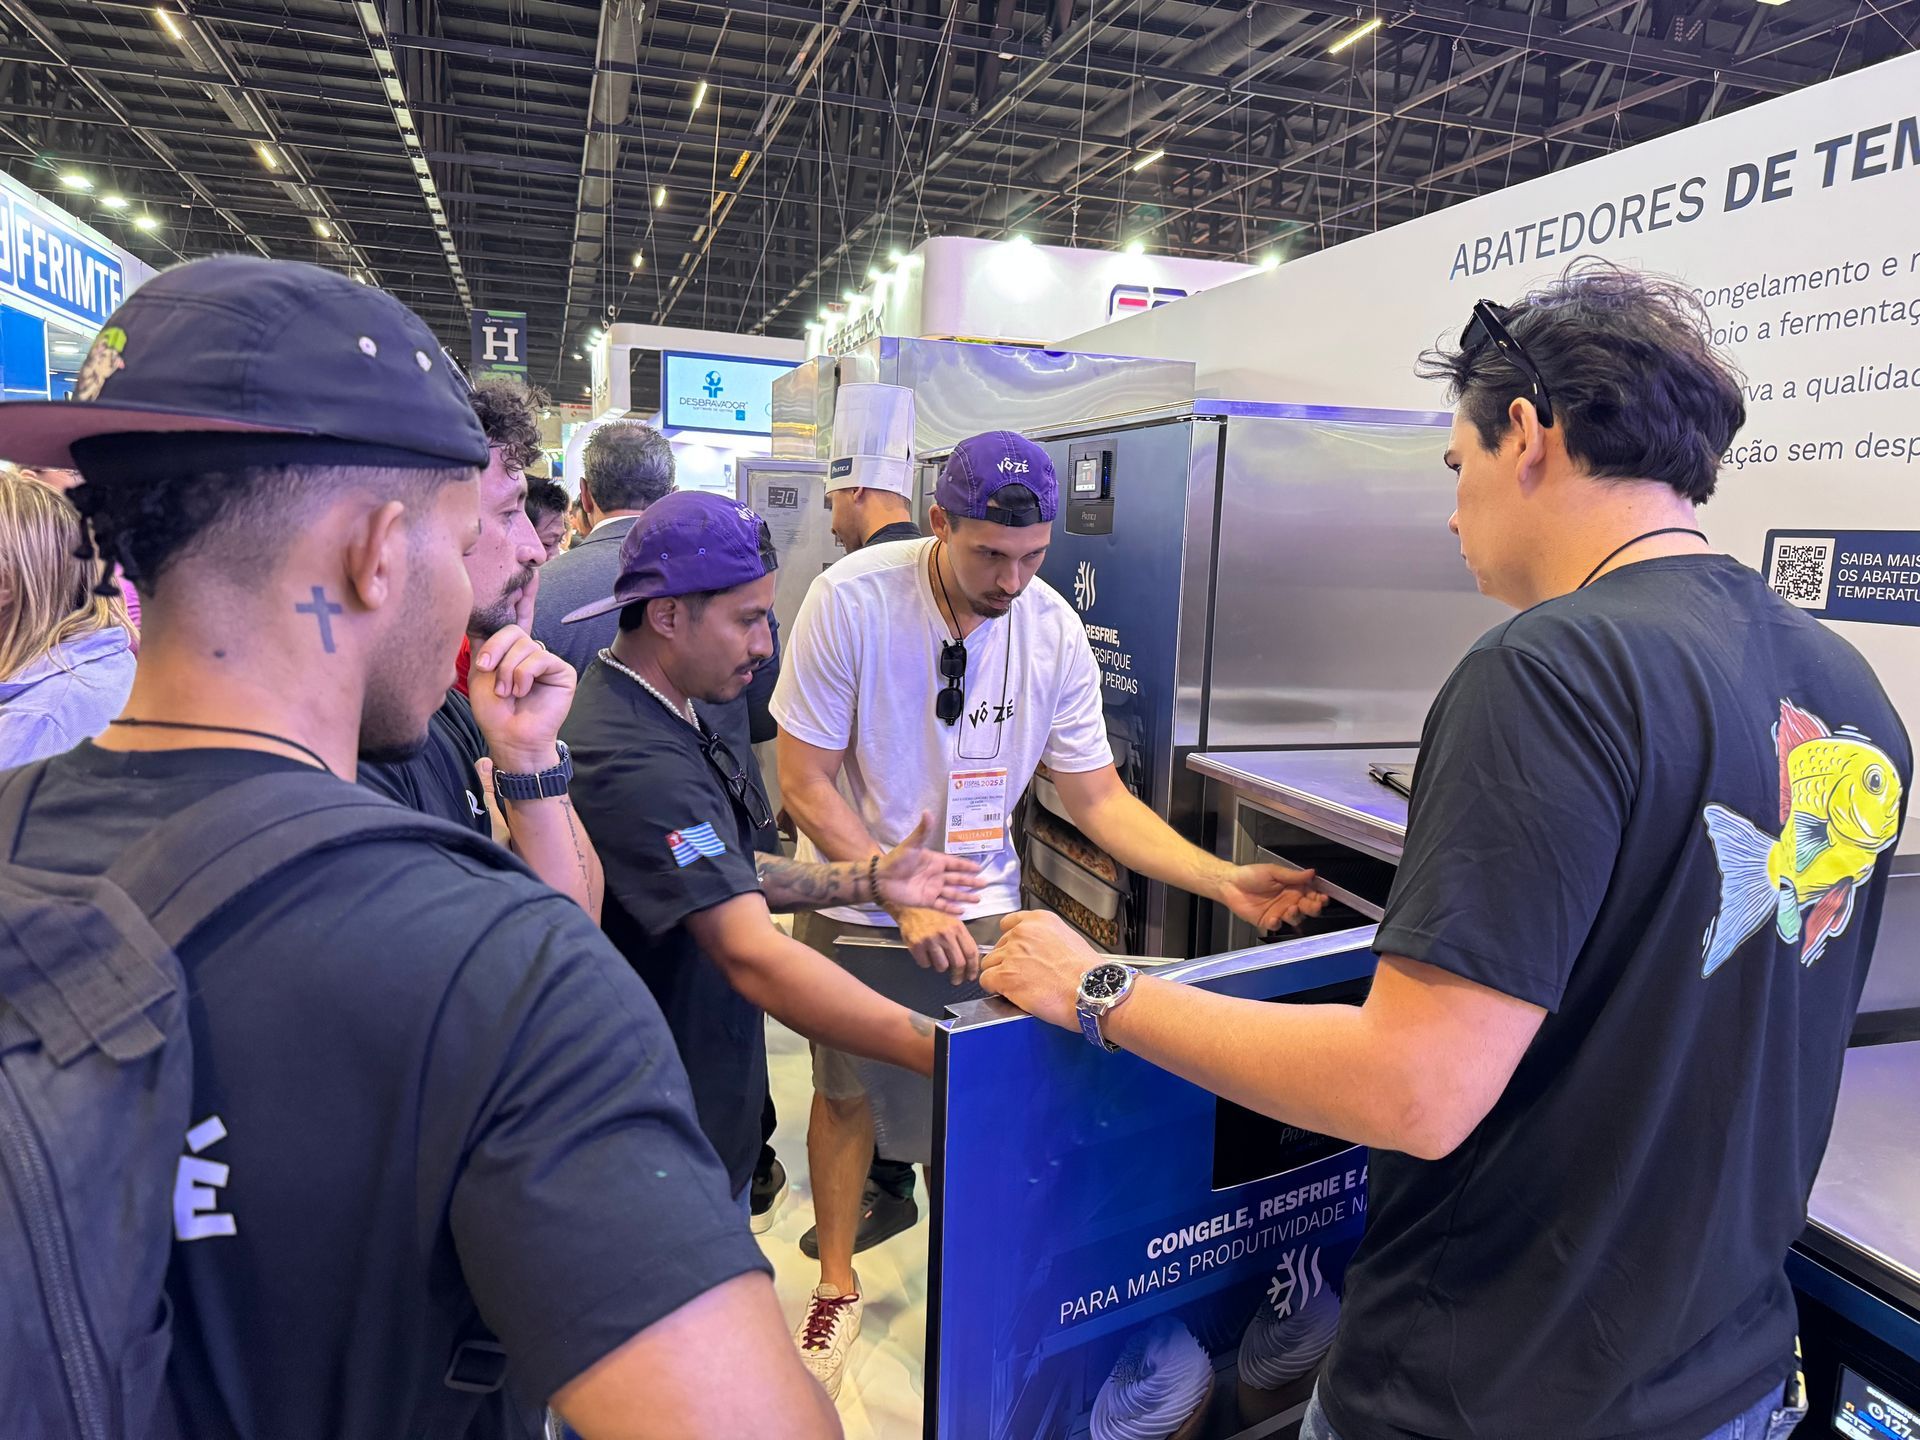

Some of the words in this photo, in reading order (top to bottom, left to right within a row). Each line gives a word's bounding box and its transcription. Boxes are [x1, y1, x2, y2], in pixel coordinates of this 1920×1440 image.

[1449, 176, 1707, 281] ABATEDORES
[1723, 149, 1798, 213] DE
[1882, 256, 1898, 277] e
[1757, 321, 1771, 340] a
[482, 326, 519, 362] H
[1782, 380, 1797, 399] a
[679, 396, 747, 410] DESBRAVADOR
[1787, 440, 1844, 461] sem
[1839, 552, 1882, 567] SAIBA
[1838, 569, 1858, 582] OS
[1105, 671, 1138, 695] PERDAS
[1146, 1206, 1254, 1260] CONGELE,
[1259, 1174, 1341, 1220] RESFRIE
[1344, 1169, 1357, 1190] E
[1060, 1285, 1120, 1325] PARA
[1127, 1262, 1181, 1299] MAIS
[1189, 1200, 1346, 1276] PRODUTIVIDADE
